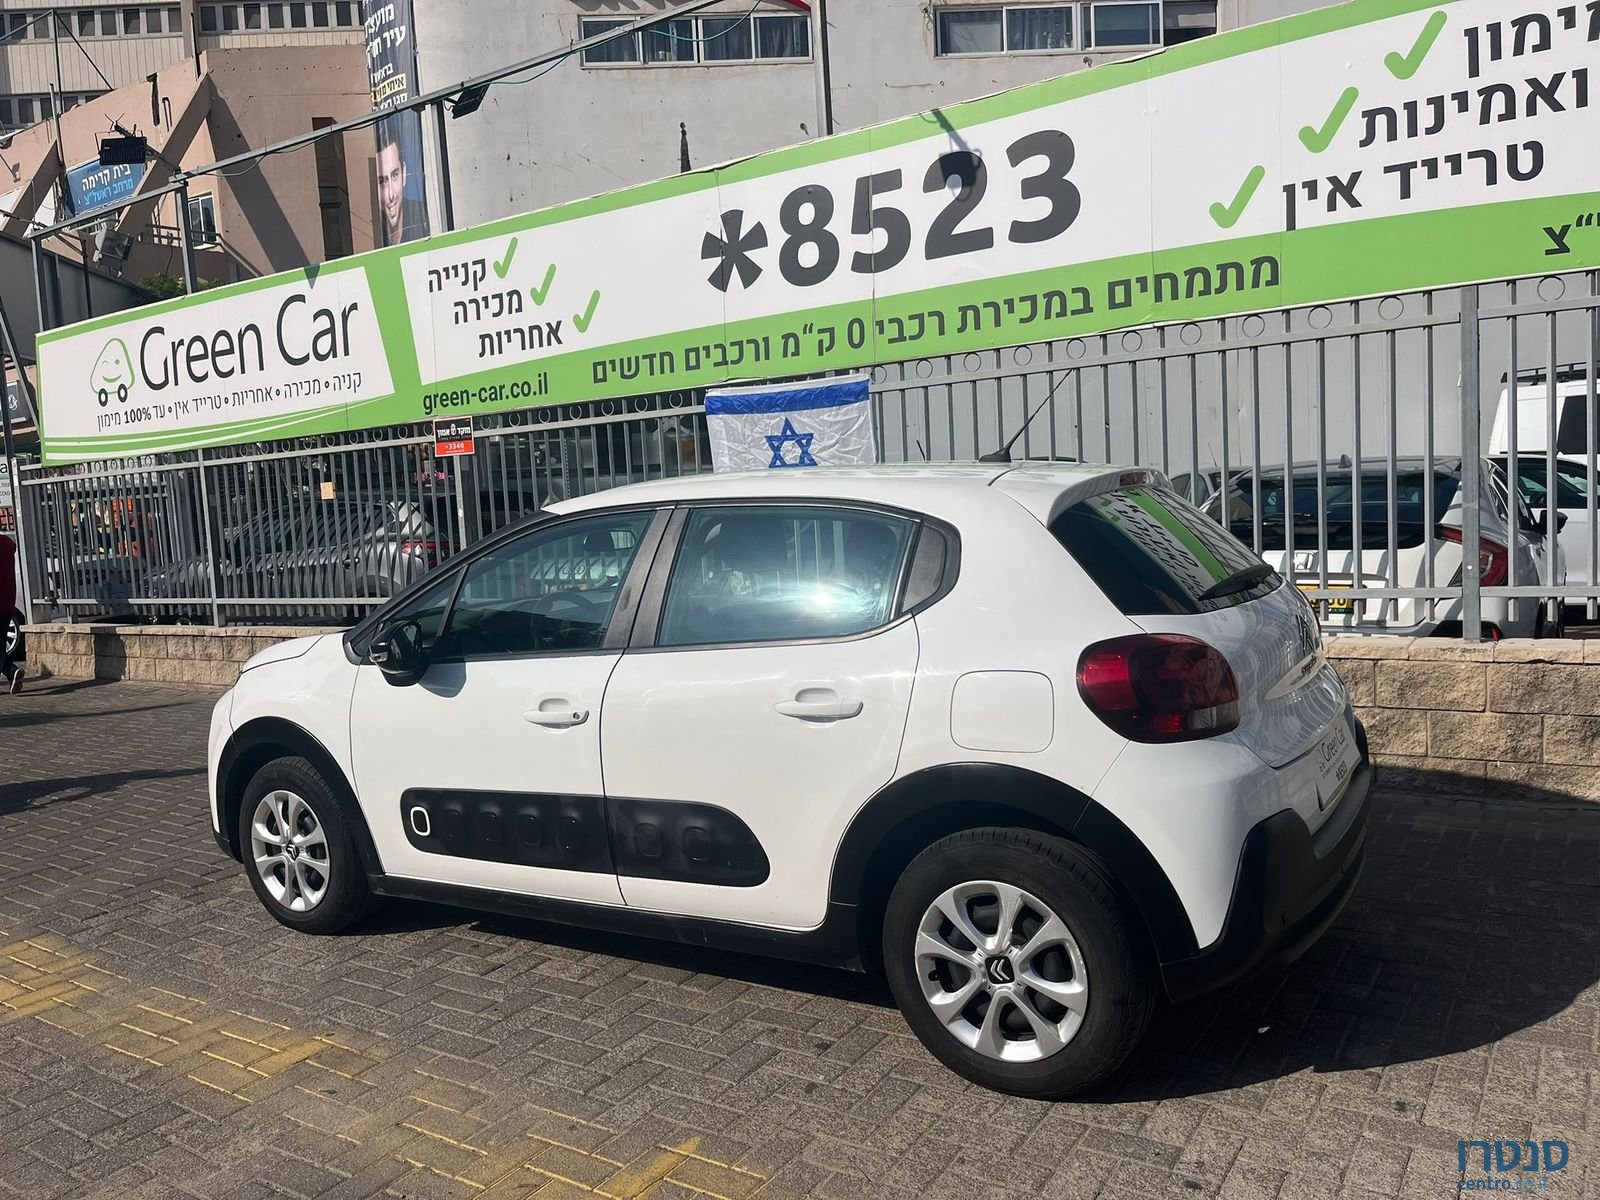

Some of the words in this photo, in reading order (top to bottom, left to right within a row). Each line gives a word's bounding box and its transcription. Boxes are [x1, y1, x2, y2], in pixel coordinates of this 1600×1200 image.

[383, 25, 406, 47] עיר
[1359, 67, 1588, 148] ואמינות
[82, 168, 110, 191] קדימה
[113, 163, 131, 179] בית
[113, 179, 134, 193] מרחב
[1383, 140, 1544, 200] טרייד
[1282, 170, 1363, 231] אין
[428, 258, 487, 293] קנייה
[1106, 255, 1280, 311] מתמחים
[453, 289, 523, 325] מכירה
[957, 286, 1094, 334] במכירת
[140, 325, 265, 391] Green
[276, 293, 358, 366] Car
[479, 320, 564, 359] אחריות
[847, 317, 866, 350] 0
[874, 309, 946, 345] רכבי
[592, 350, 675, 384] חדשים
[684, 336, 771, 372] ורכבים
[232, 385, 274, 407] אחריות
[284, 378, 321, 400] מכירה
[333, 372, 362, 394] קניה
[423, 371, 549, 416] green-car.co.il
[124, 406, 152, 424] 100%
[153, 404, 167, 420] עד
[174, 399, 190, 421] אין
[192, 394, 222, 413] טרייד
[97, 411, 122, 433] מימון
